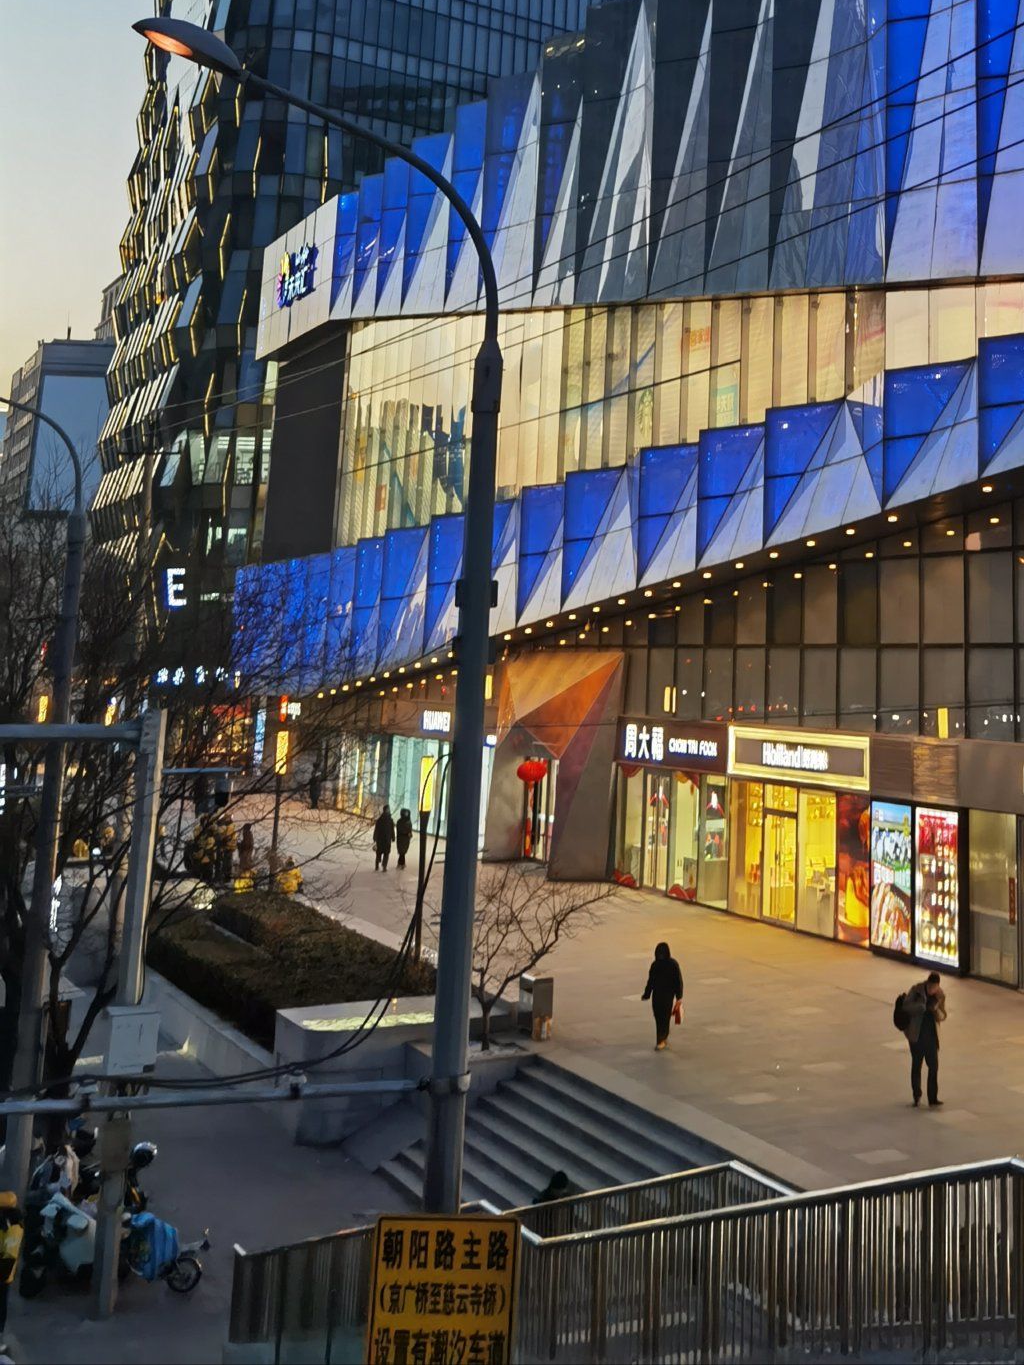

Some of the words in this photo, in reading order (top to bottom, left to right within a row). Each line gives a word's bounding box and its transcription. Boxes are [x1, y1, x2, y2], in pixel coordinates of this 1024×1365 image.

[167, 567, 187, 606] E
[423, 710, 450, 732] HUAWEI
[625, 723, 664, 761] 周大福
[382, 1228, 509, 1271] 朝阳路主路
